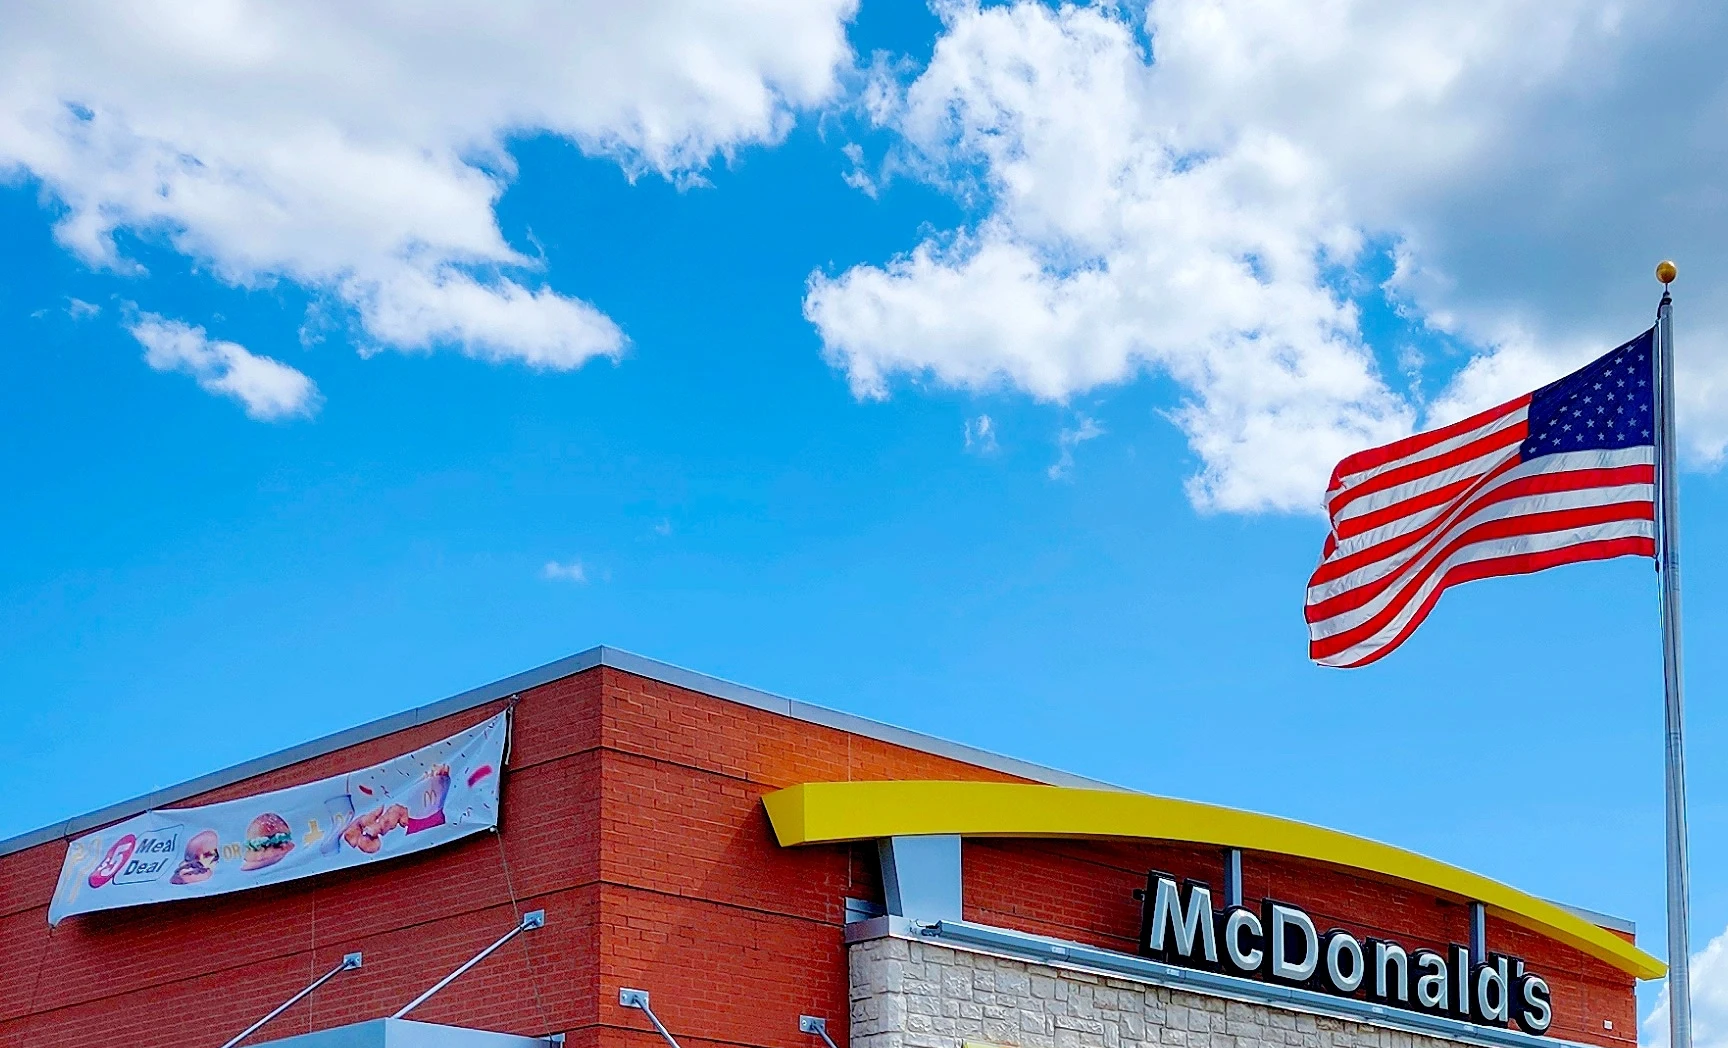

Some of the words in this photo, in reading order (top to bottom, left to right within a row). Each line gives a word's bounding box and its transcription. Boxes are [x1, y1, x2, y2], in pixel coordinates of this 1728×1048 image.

[135, 833, 178, 853] Meal
[222, 843, 242, 861] OR
[125, 859, 166, 876] Deal
[1146, 869, 1553, 1034] McDonald's
